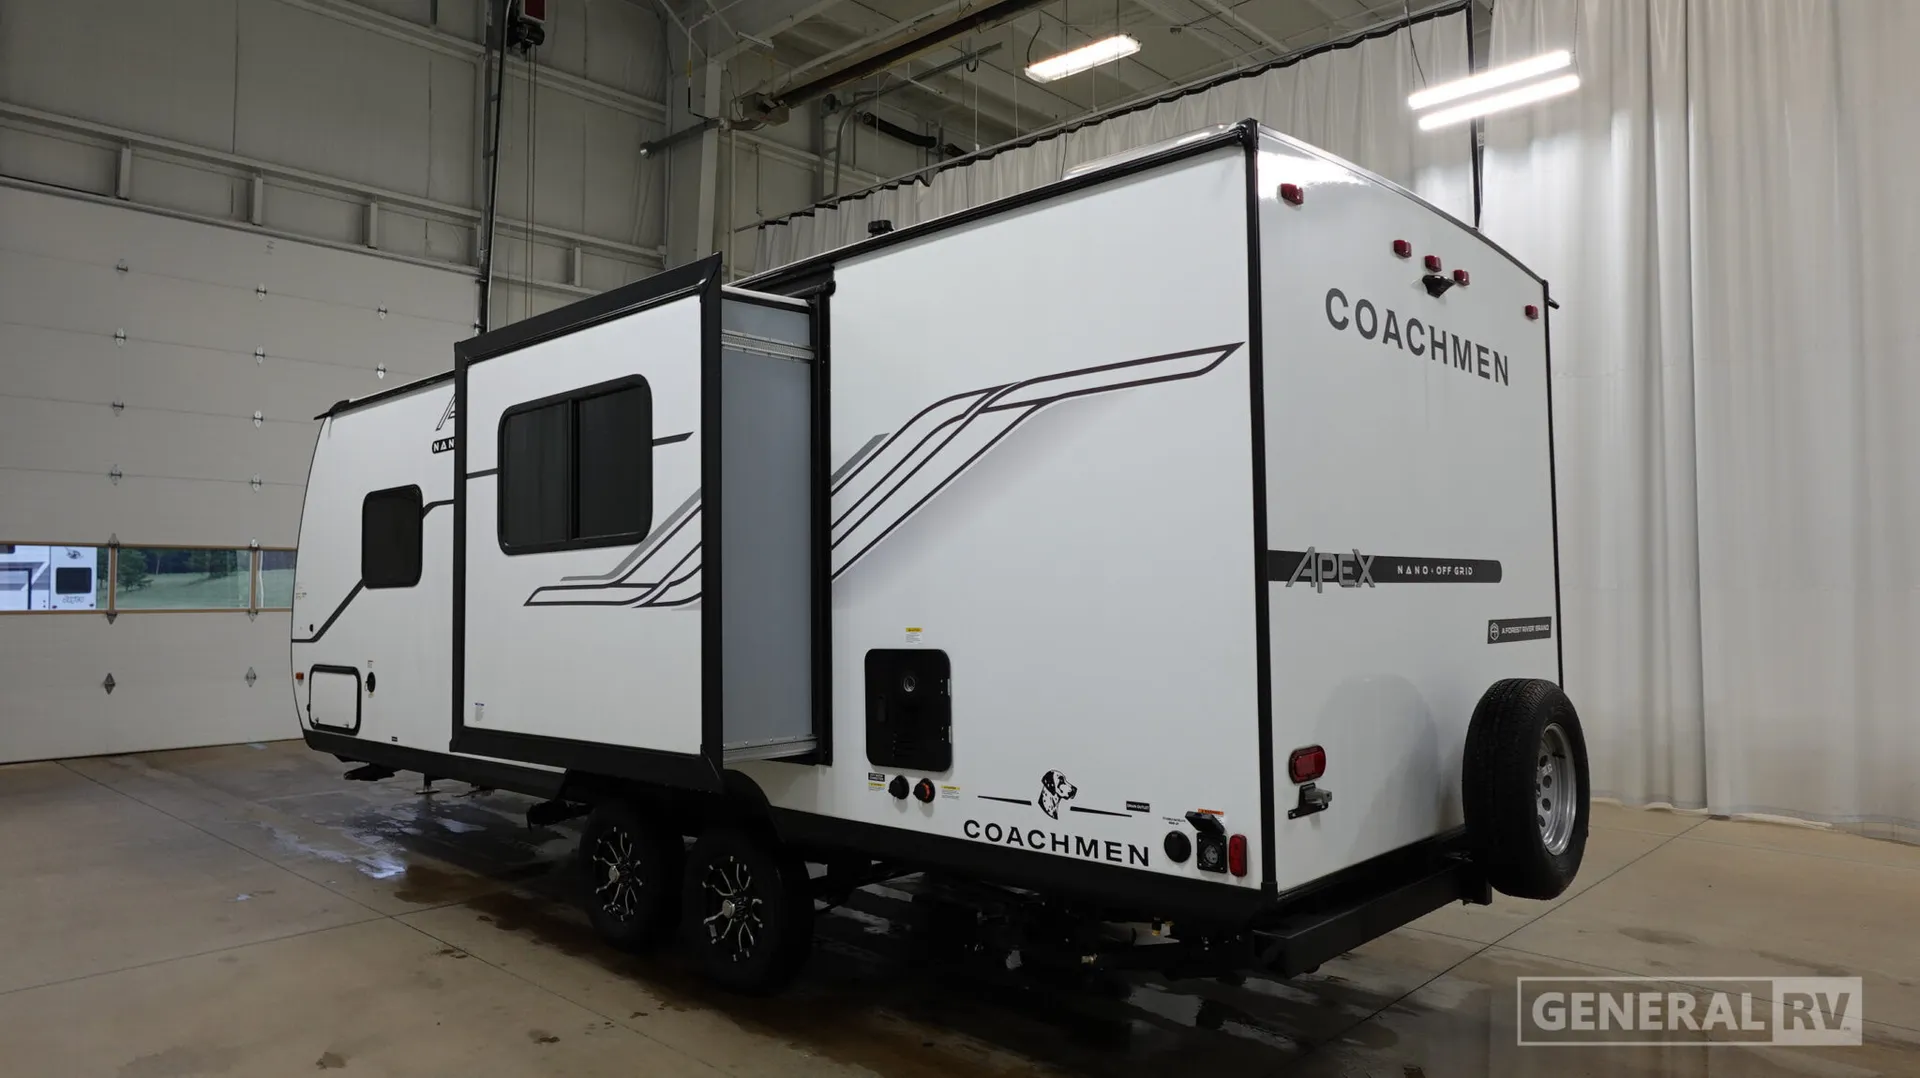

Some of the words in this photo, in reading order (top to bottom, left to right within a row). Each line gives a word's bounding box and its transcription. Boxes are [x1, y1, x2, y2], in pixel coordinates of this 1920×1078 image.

[1325, 287, 1509, 387] COACHMEN
[433, 438, 455, 452] NAN
[1286, 546, 1376, 594] APEX
[1397, 565, 1429, 575] NANO
[1436, 566, 1451, 576] OFF
[1454, 566, 1473, 576] GRID
[963, 819, 1150, 867] COACHMEN
